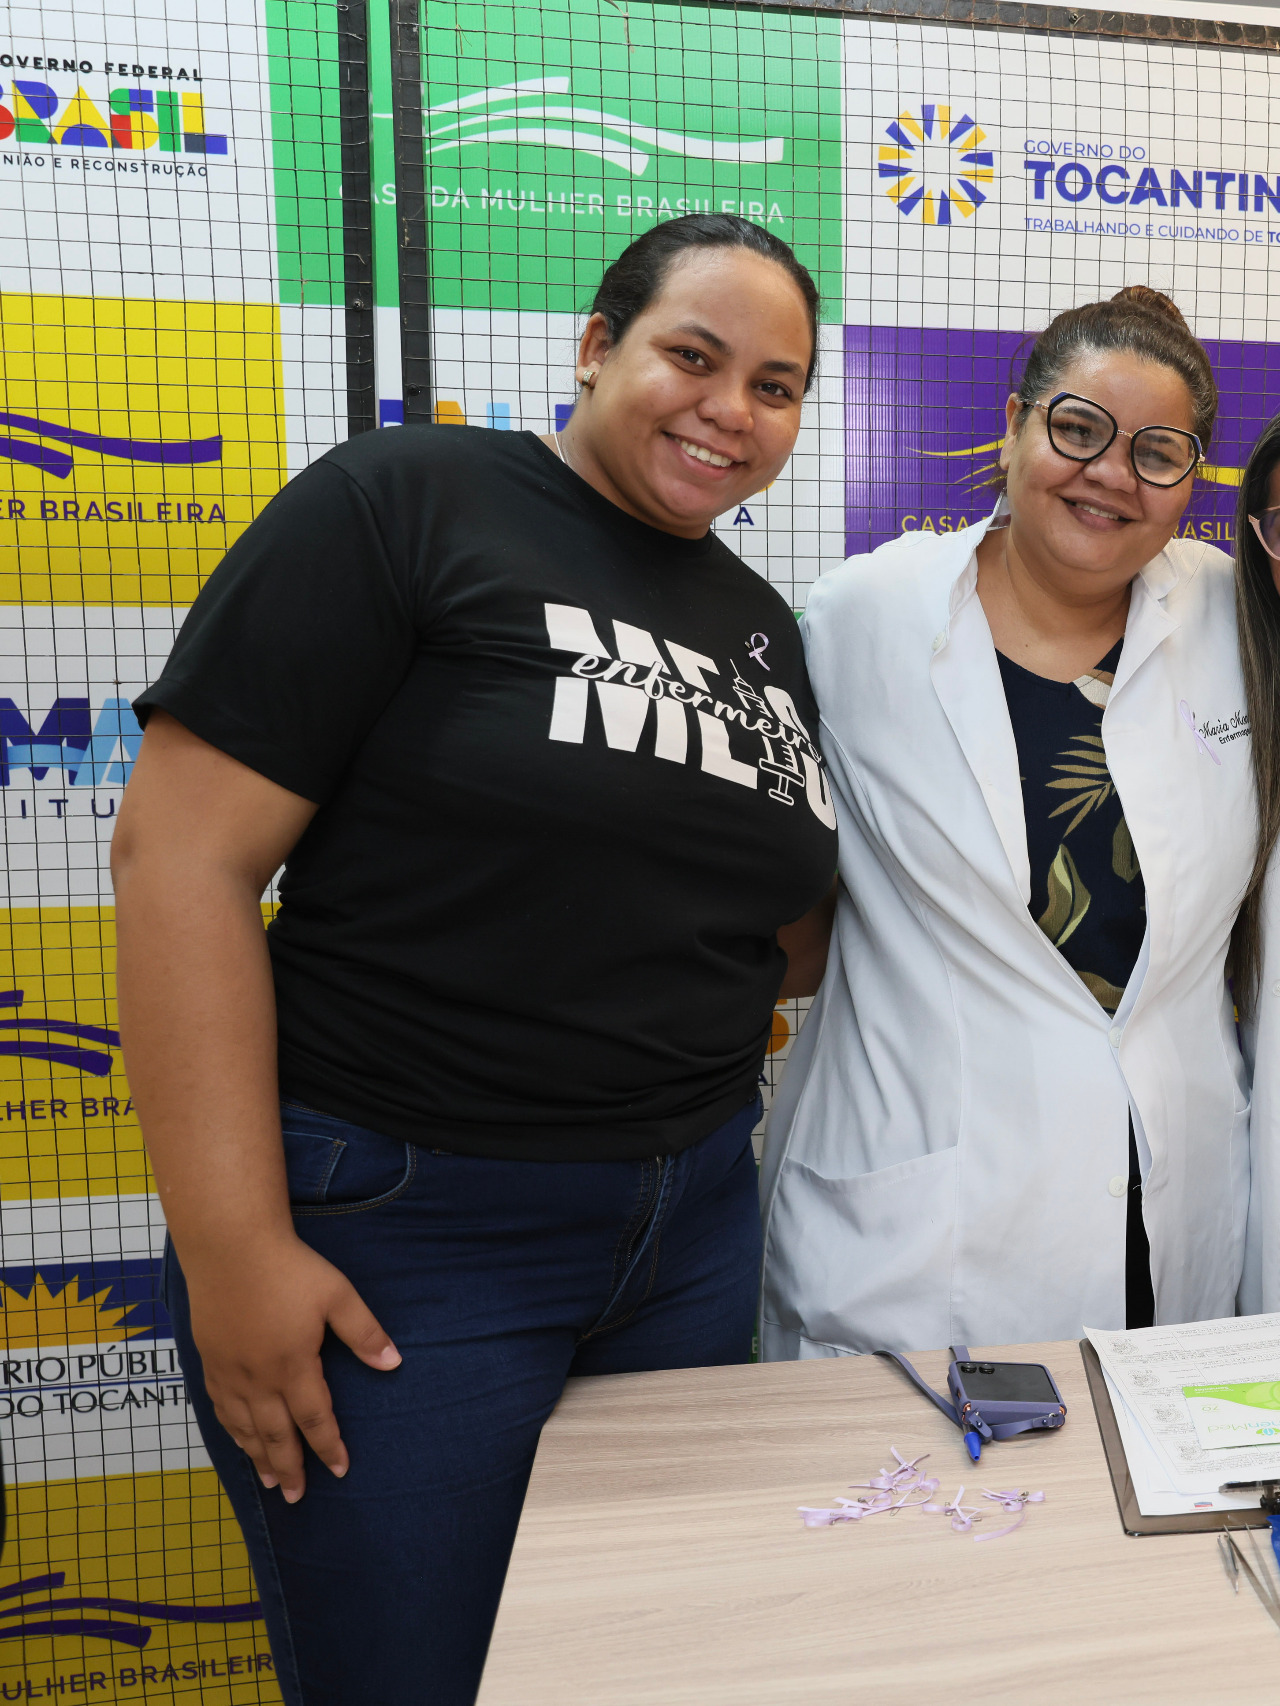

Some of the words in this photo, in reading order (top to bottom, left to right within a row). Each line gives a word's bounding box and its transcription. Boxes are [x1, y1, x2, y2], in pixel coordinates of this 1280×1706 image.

[104, 62, 203, 82] FEDERAL
[1024, 140, 1114, 159] GOVERNO
[1119, 146, 1146, 160] DO
[54, 157, 62, 169] E
[71, 158, 208, 178] RECONSTRUÇÃO
[431, 185, 471, 209] DA
[481, 188, 604, 216] MULHER
[617, 195, 785, 224] BRASILEIRA
[1024, 217, 1141, 237] TRABALHANDO
[1145, 224, 1154, 236] E
[1158, 225, 1240, 241] CUIDANDO
[1243, 229, 1264, 243] DE
[40, 499, 226, 523] BRASILEIRA
[902, 515, 969, 534] CASA
[0, 1098, 68, 1120] HER
[52, 1384, 192, 1415] TOCANT
